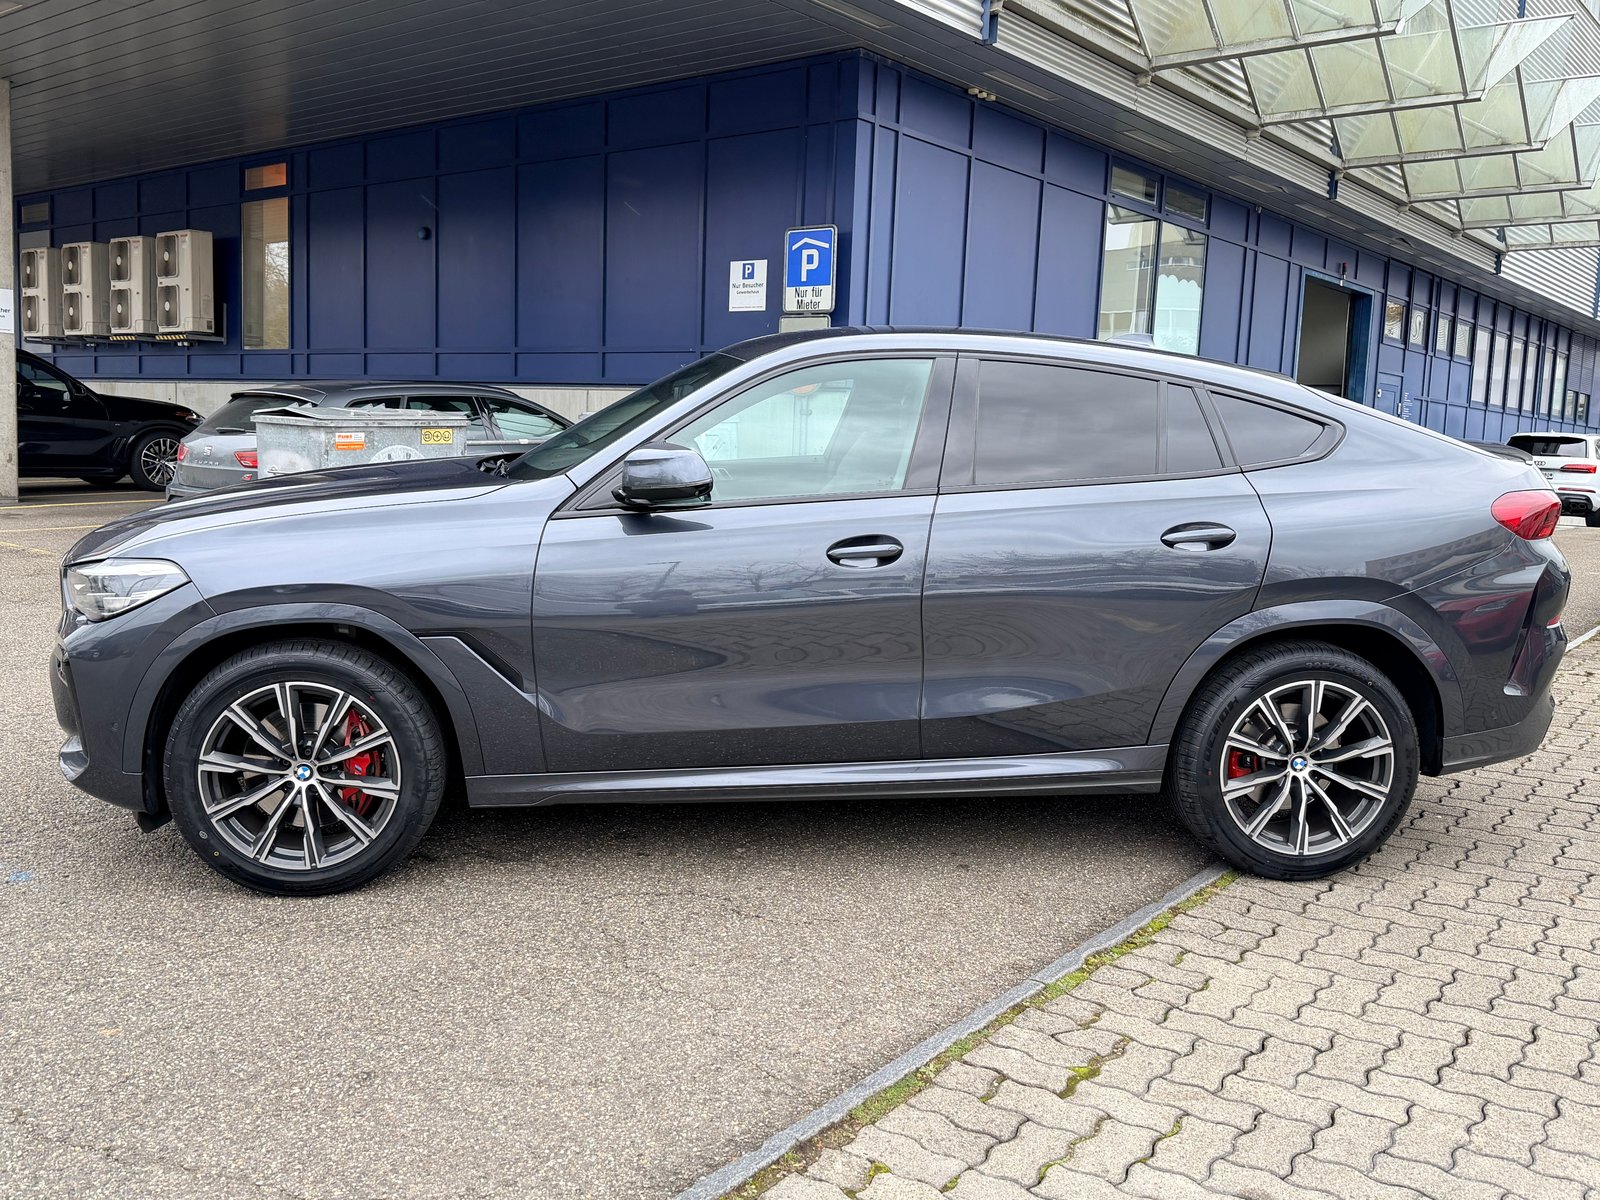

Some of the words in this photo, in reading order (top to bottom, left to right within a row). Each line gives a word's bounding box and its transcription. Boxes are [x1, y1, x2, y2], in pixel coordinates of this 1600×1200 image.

[745, 264, 753, 278] P
[801, 249, 820, 282] P
[795, 287, 808, 298] Nur
[812, 286, 823, 297] für
[797, 299, 821, 310] Mieter
